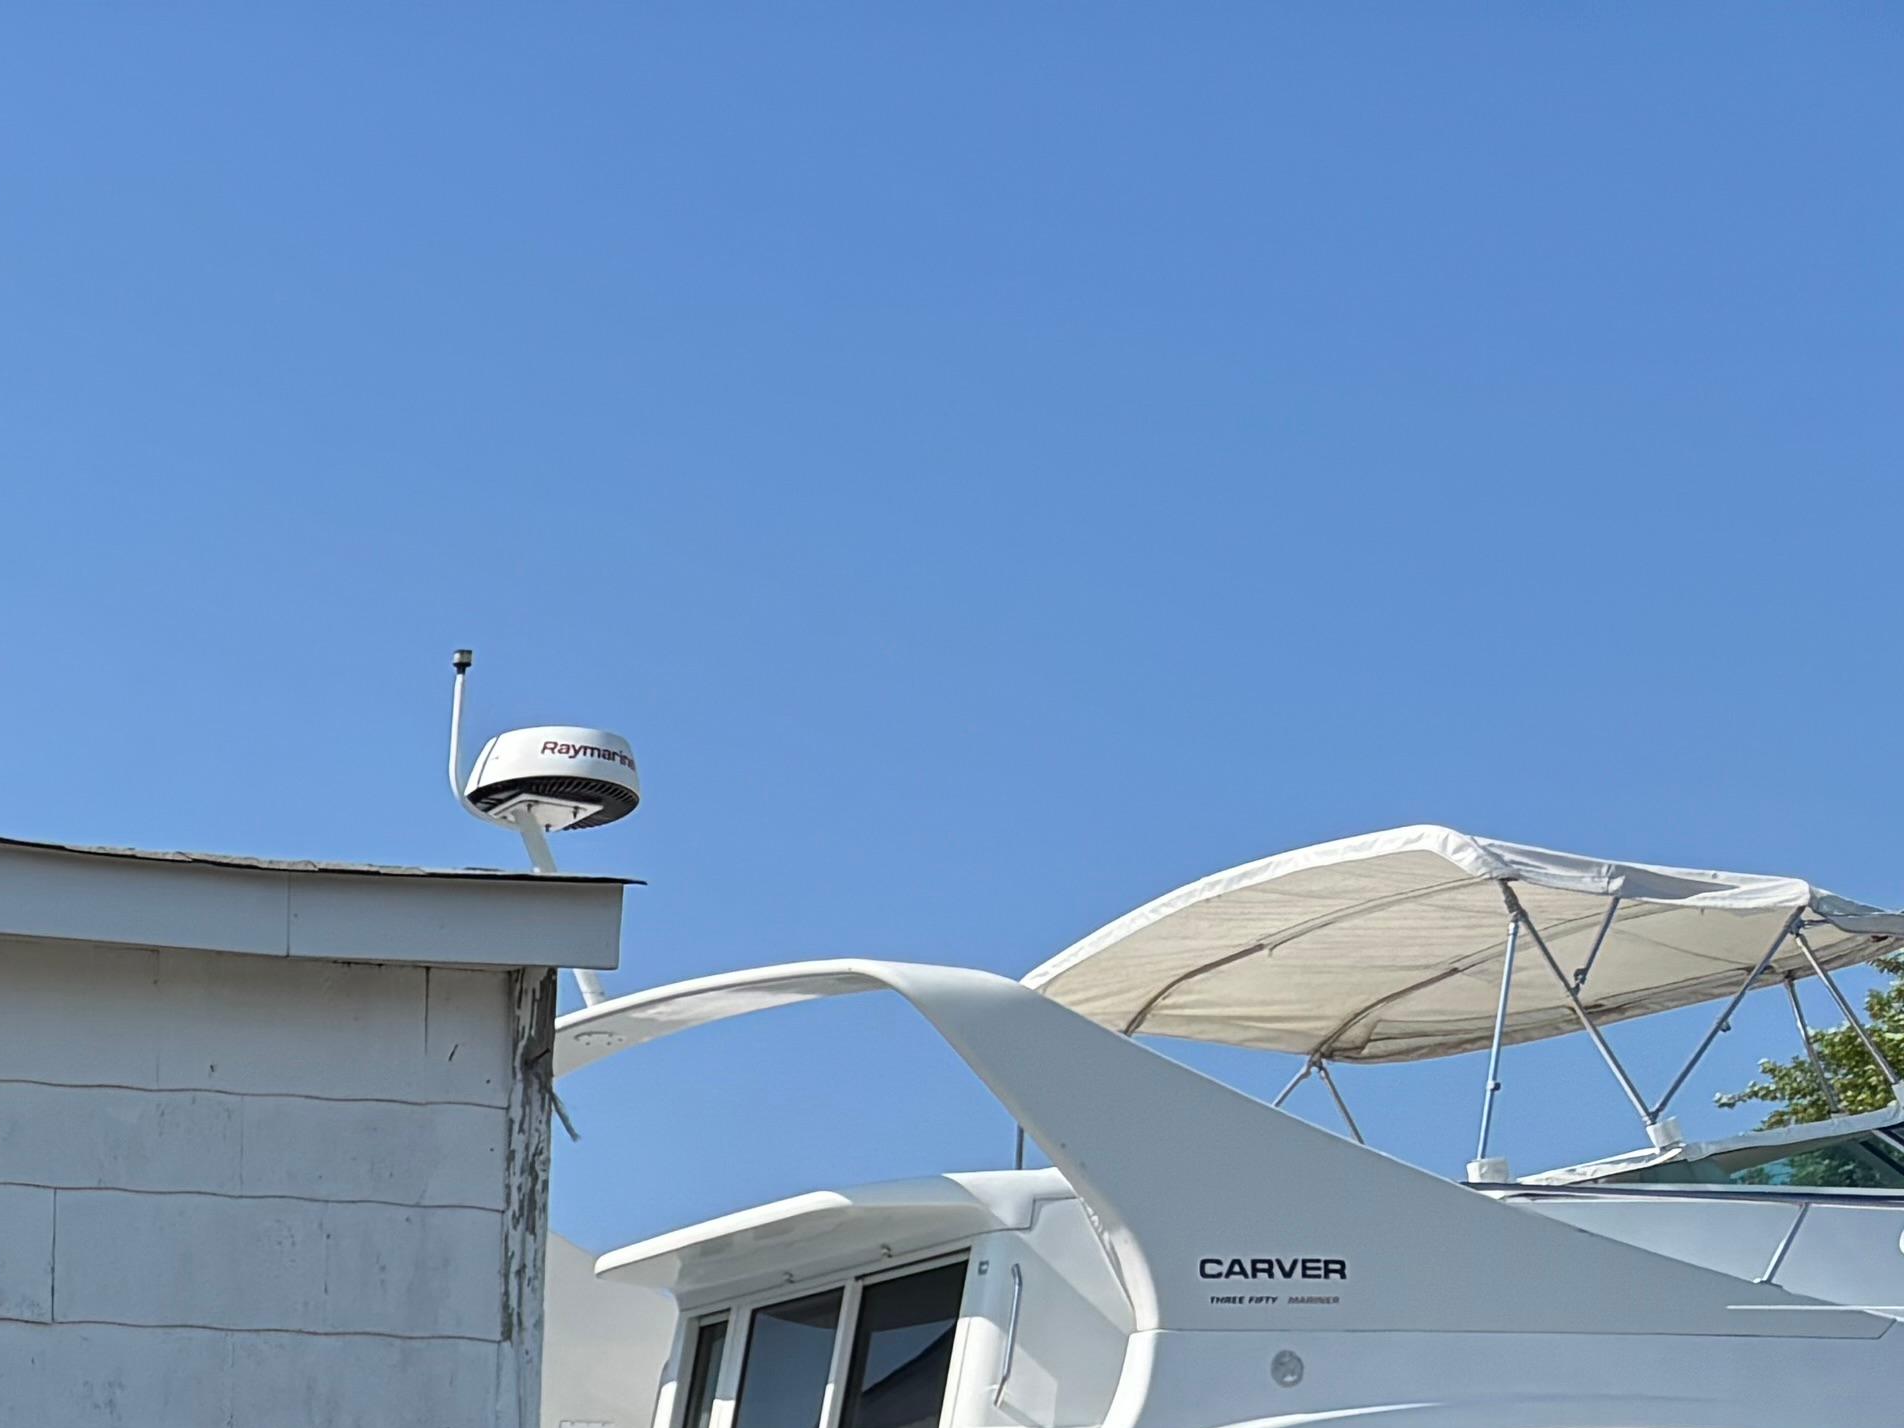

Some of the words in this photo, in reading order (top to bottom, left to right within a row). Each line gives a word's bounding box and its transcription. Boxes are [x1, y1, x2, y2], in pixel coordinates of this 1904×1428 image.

[1199, 1258, 1347, 1280] CARVER
[1210, 1296, 1245, 1304] THREE
[1248, 1296, 1278, 1304] FIFTY
